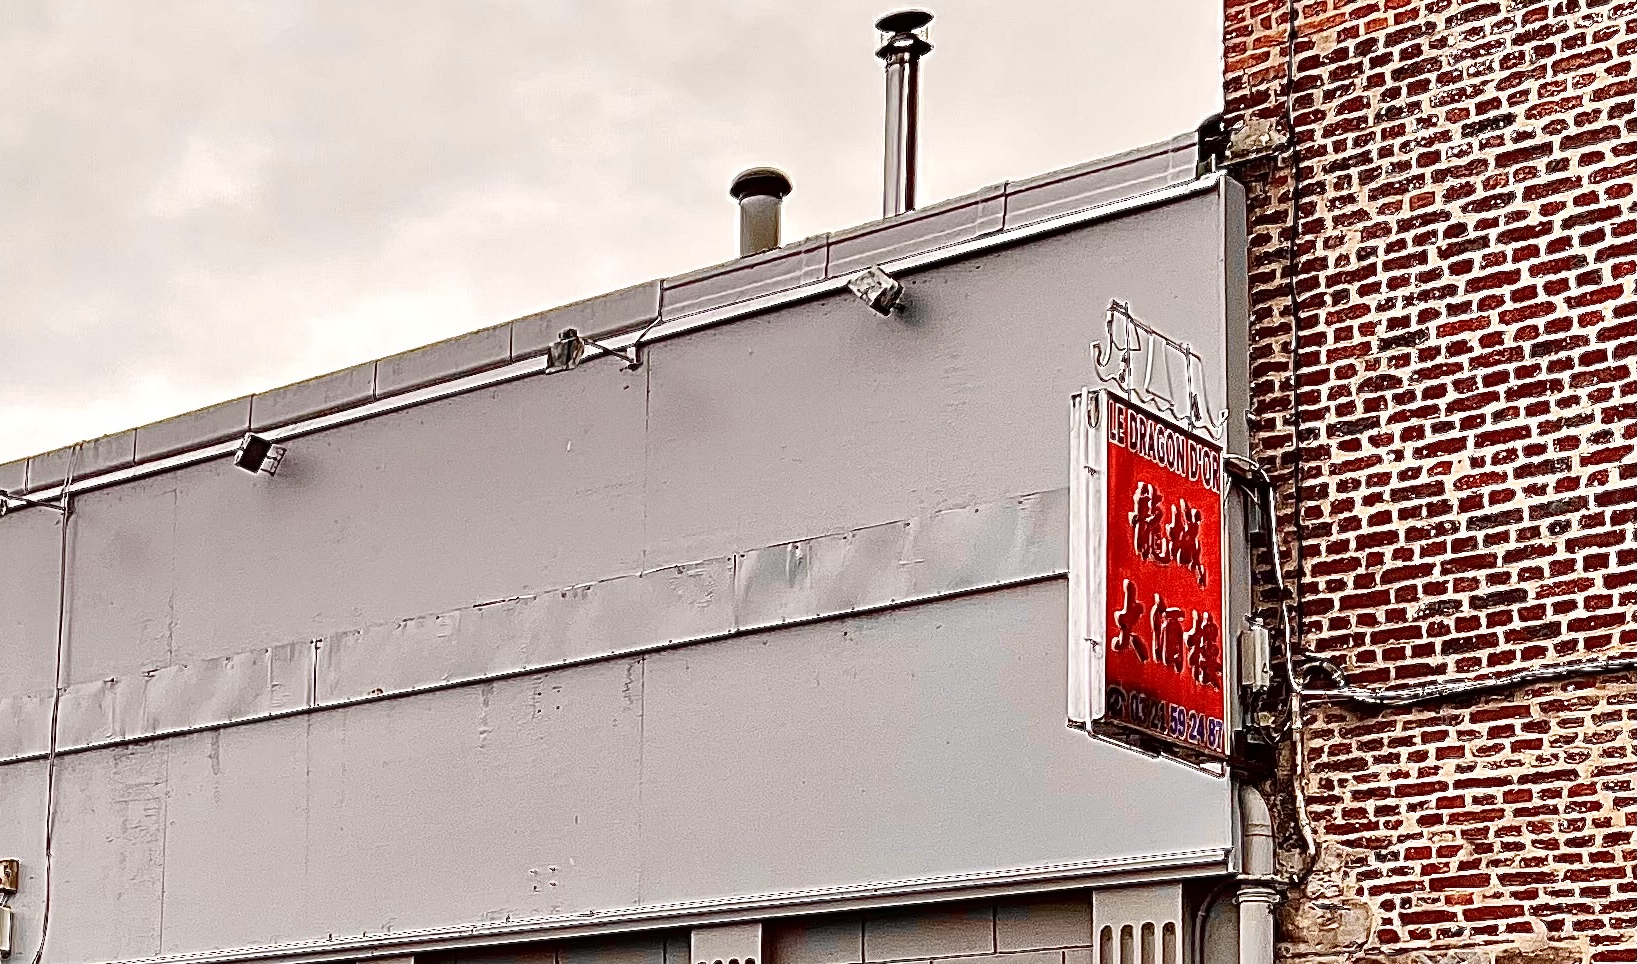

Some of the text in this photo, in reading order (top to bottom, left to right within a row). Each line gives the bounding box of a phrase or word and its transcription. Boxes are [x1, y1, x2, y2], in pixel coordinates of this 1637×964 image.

[1109, 400, 1221, 495] LE DRAGON D'OR
[1168, 703, 1187, 740] 59
[1187, 710, 1207, 746] 24
[1207, 717, 1223, 752] 87
